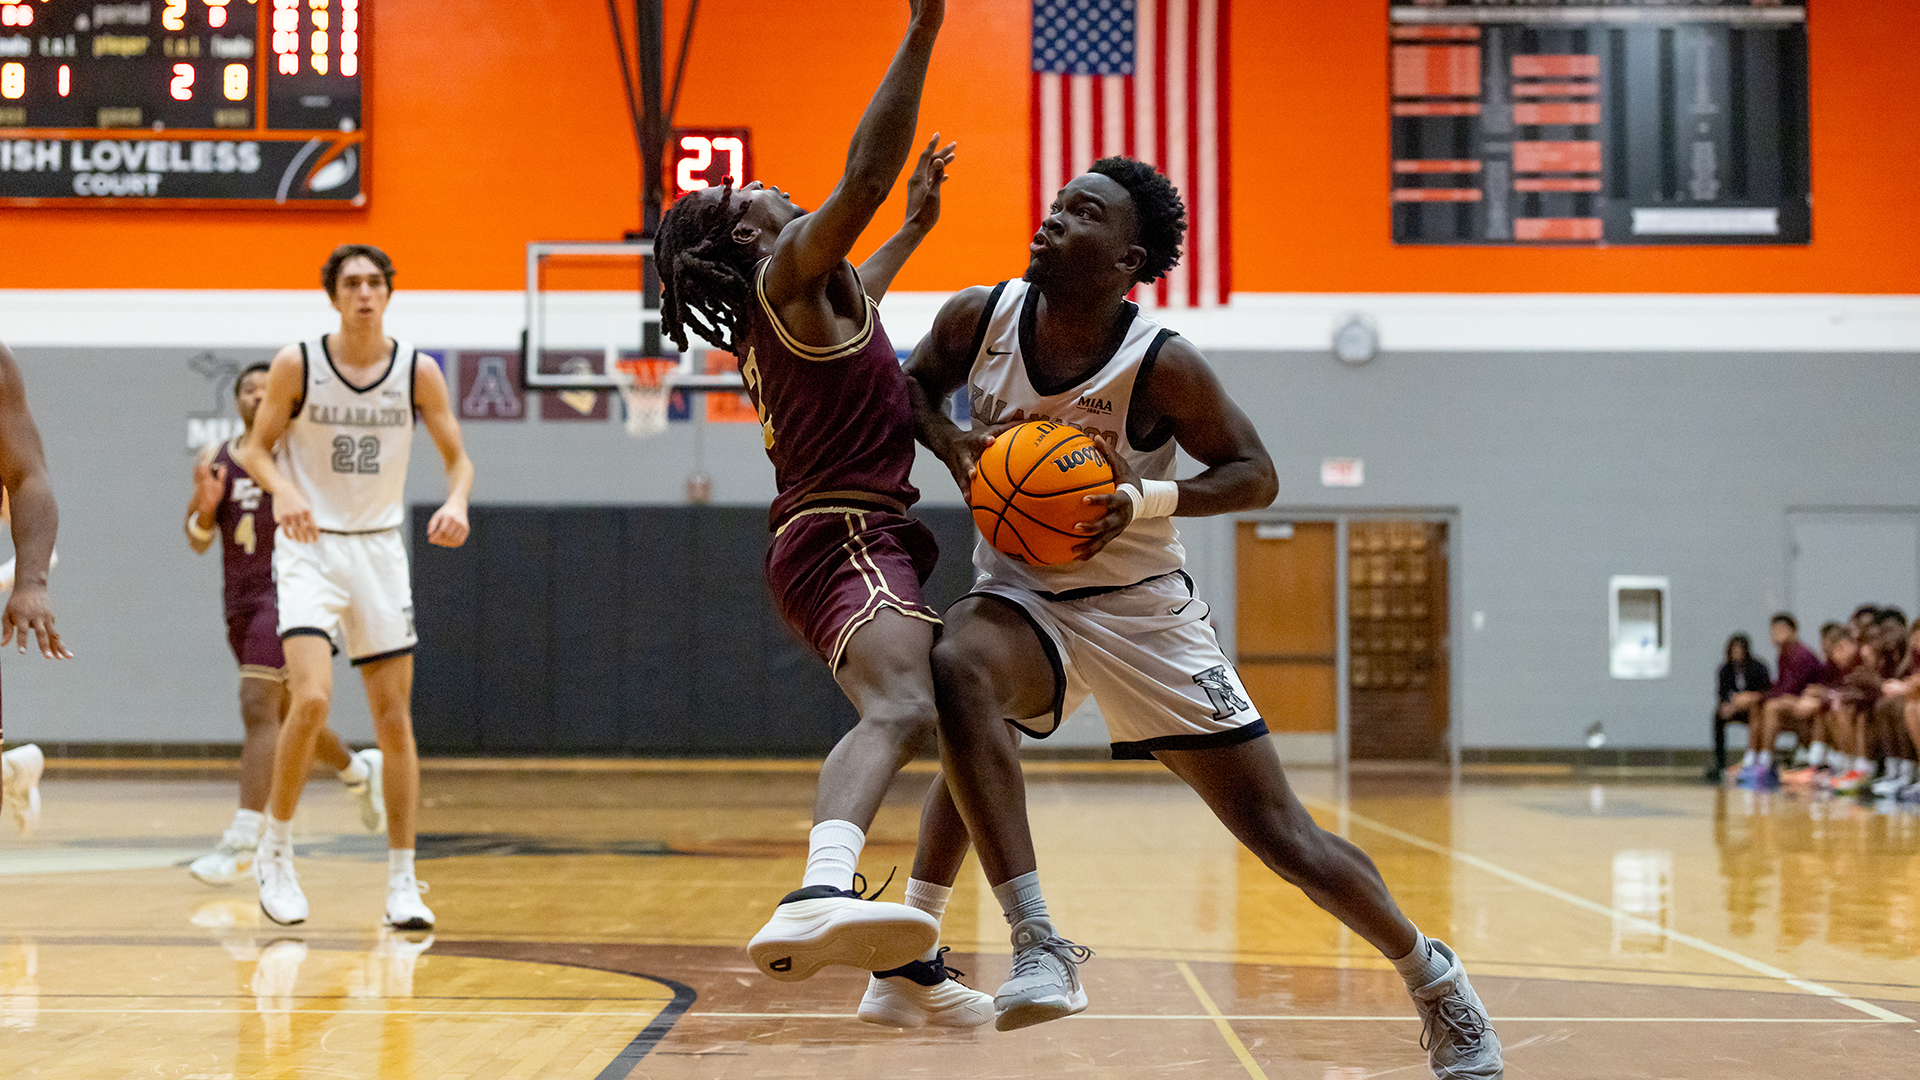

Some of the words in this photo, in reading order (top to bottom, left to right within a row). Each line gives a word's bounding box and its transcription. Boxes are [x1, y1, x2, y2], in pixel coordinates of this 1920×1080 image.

[1, 62, 25, 99] 8
[57, 64, 71, 97] 1
[170, 63, 195, 101] 2
[223, 63, 249, 101] 8
[70, 140, 261, 173] LOVELESS
[676, 135, 743, 192] 27
[72, 173, 162, 196] COURT
[1077, 396, 1113, 412] MIAA
[331, 434, 380, 474] 22
[233, 512, 257, 554] 4
